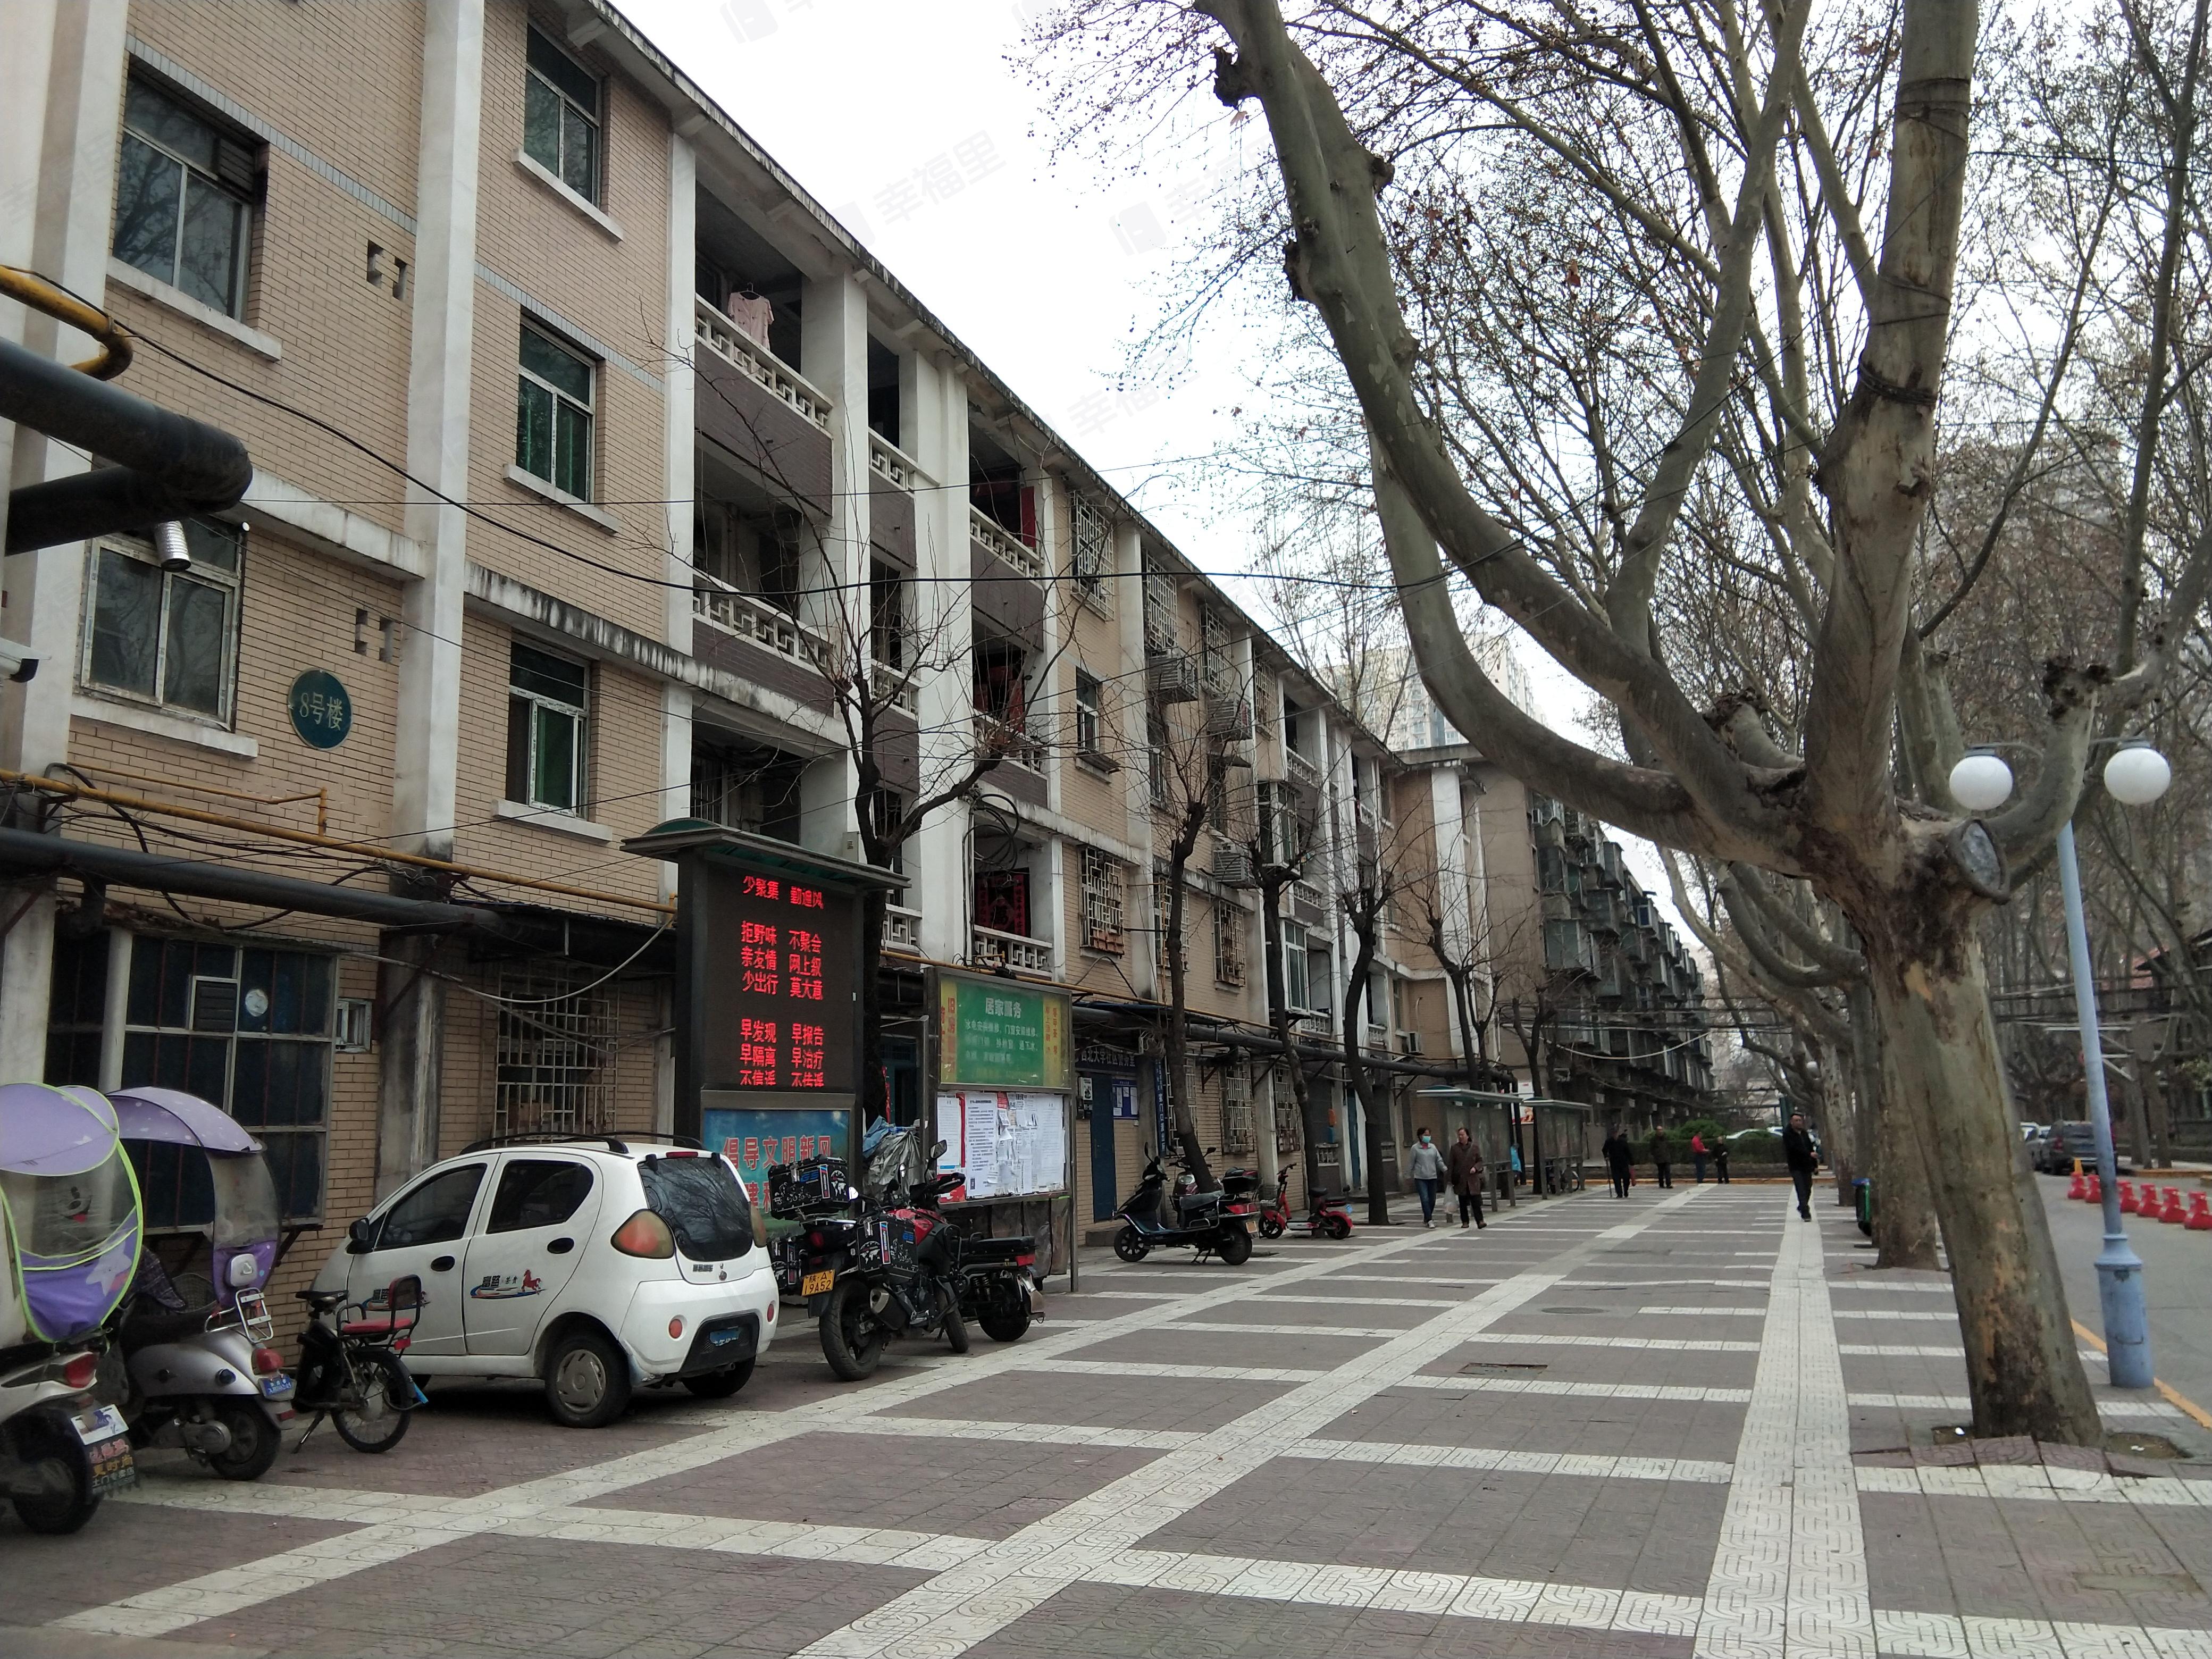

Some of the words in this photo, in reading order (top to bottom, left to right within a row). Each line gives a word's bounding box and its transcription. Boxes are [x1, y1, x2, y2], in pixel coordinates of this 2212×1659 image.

[299, 692, 343, 731] 8号楼
[743, 876, 778, 900] 少聚集
[790, 886, 824, 909] 勤通风
[741, 920, 777, 946] 拒野味
[789, 930, 822, 953] 不聚会
[741, 946, 777, 970] 亲友情
[742, 970, 778, 995] 少出行
[790, 976, 823, 1000] 莫大意
[985, 998, 1021, 1018] 居家服务
[740, 1018, 777, 1043] 早发现
[791, 1023, 824, 1046] 早报告
[740, 1043, 776, 1067] 早隔离
[791, 1047, 824, 1069] 早治疗
[740, 1070, 776, 1085] 不信谣
[791, 1072, 824, 1087] 不传谣
[723, 1135, 831, 1170] 倡导文明新风
[805, 1280, 831, 1295] 19A52
